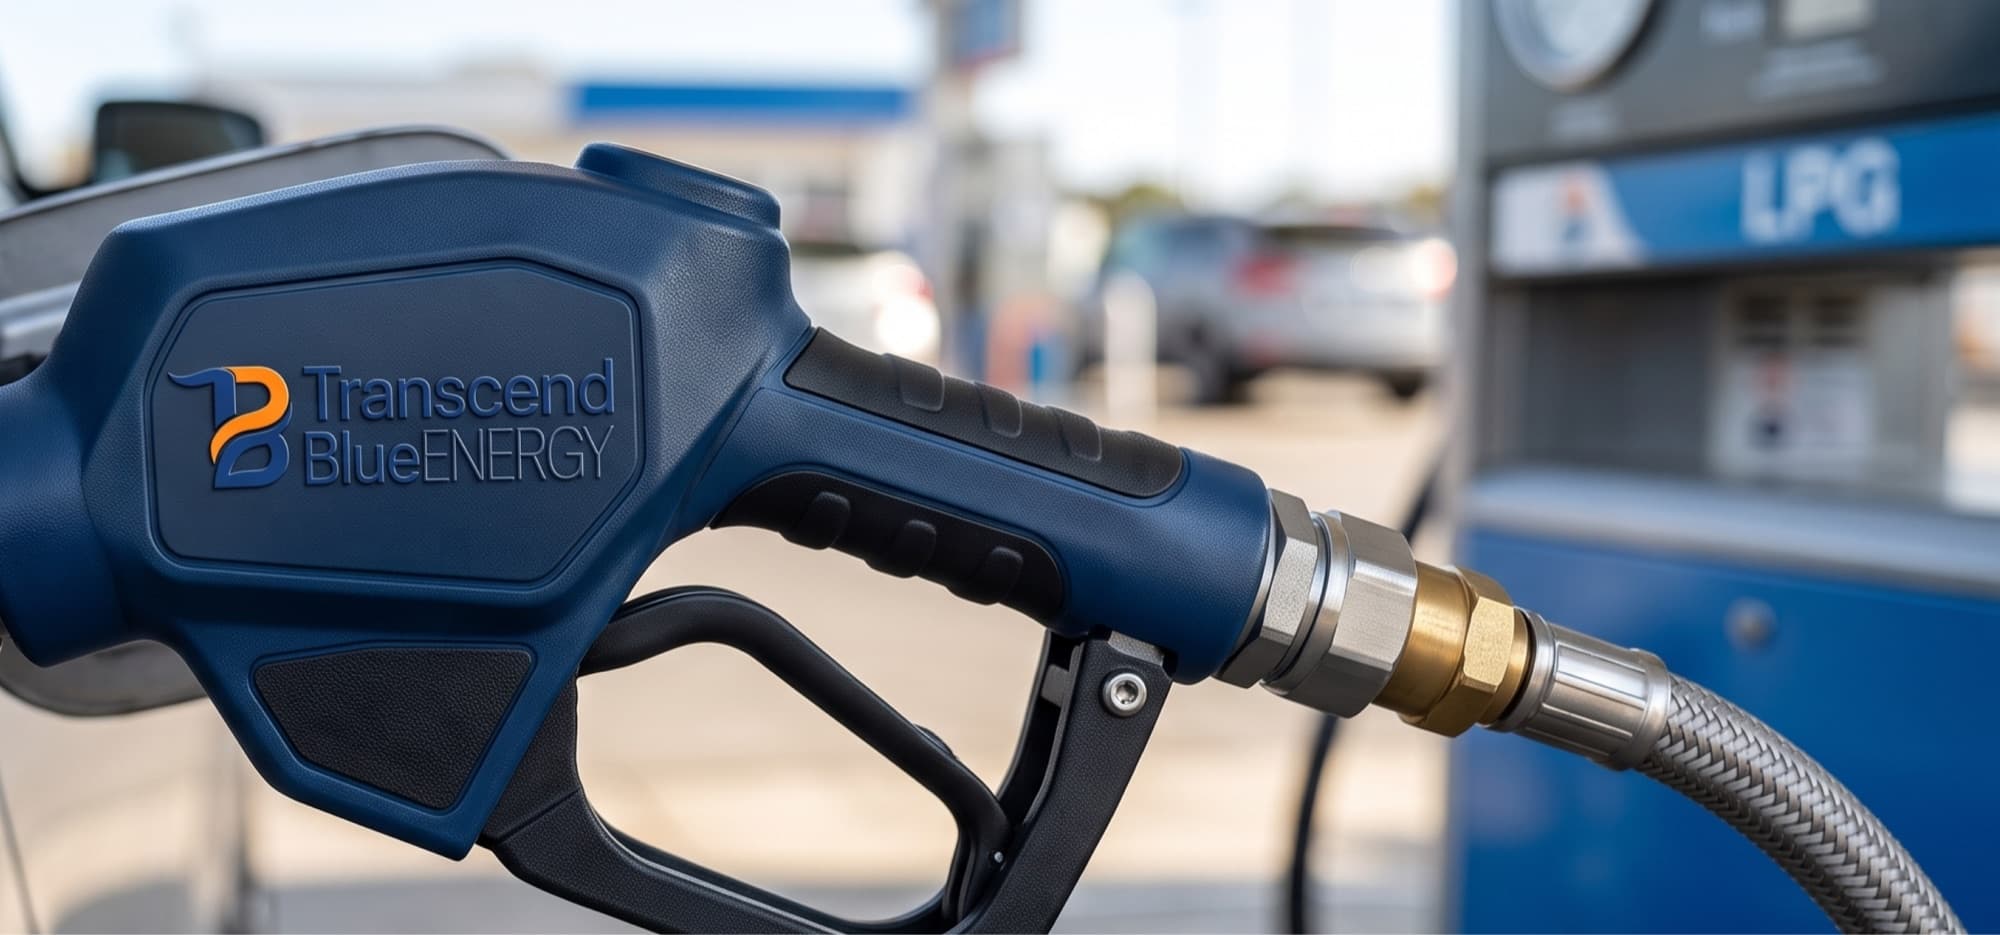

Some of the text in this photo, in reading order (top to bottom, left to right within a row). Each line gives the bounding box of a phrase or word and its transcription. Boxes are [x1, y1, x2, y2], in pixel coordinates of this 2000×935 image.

[1741, 137, 1901, 243] LPG
[303, 357, 616, 422] Transcend
[304, 424, 615, 486] BlueENERGY
